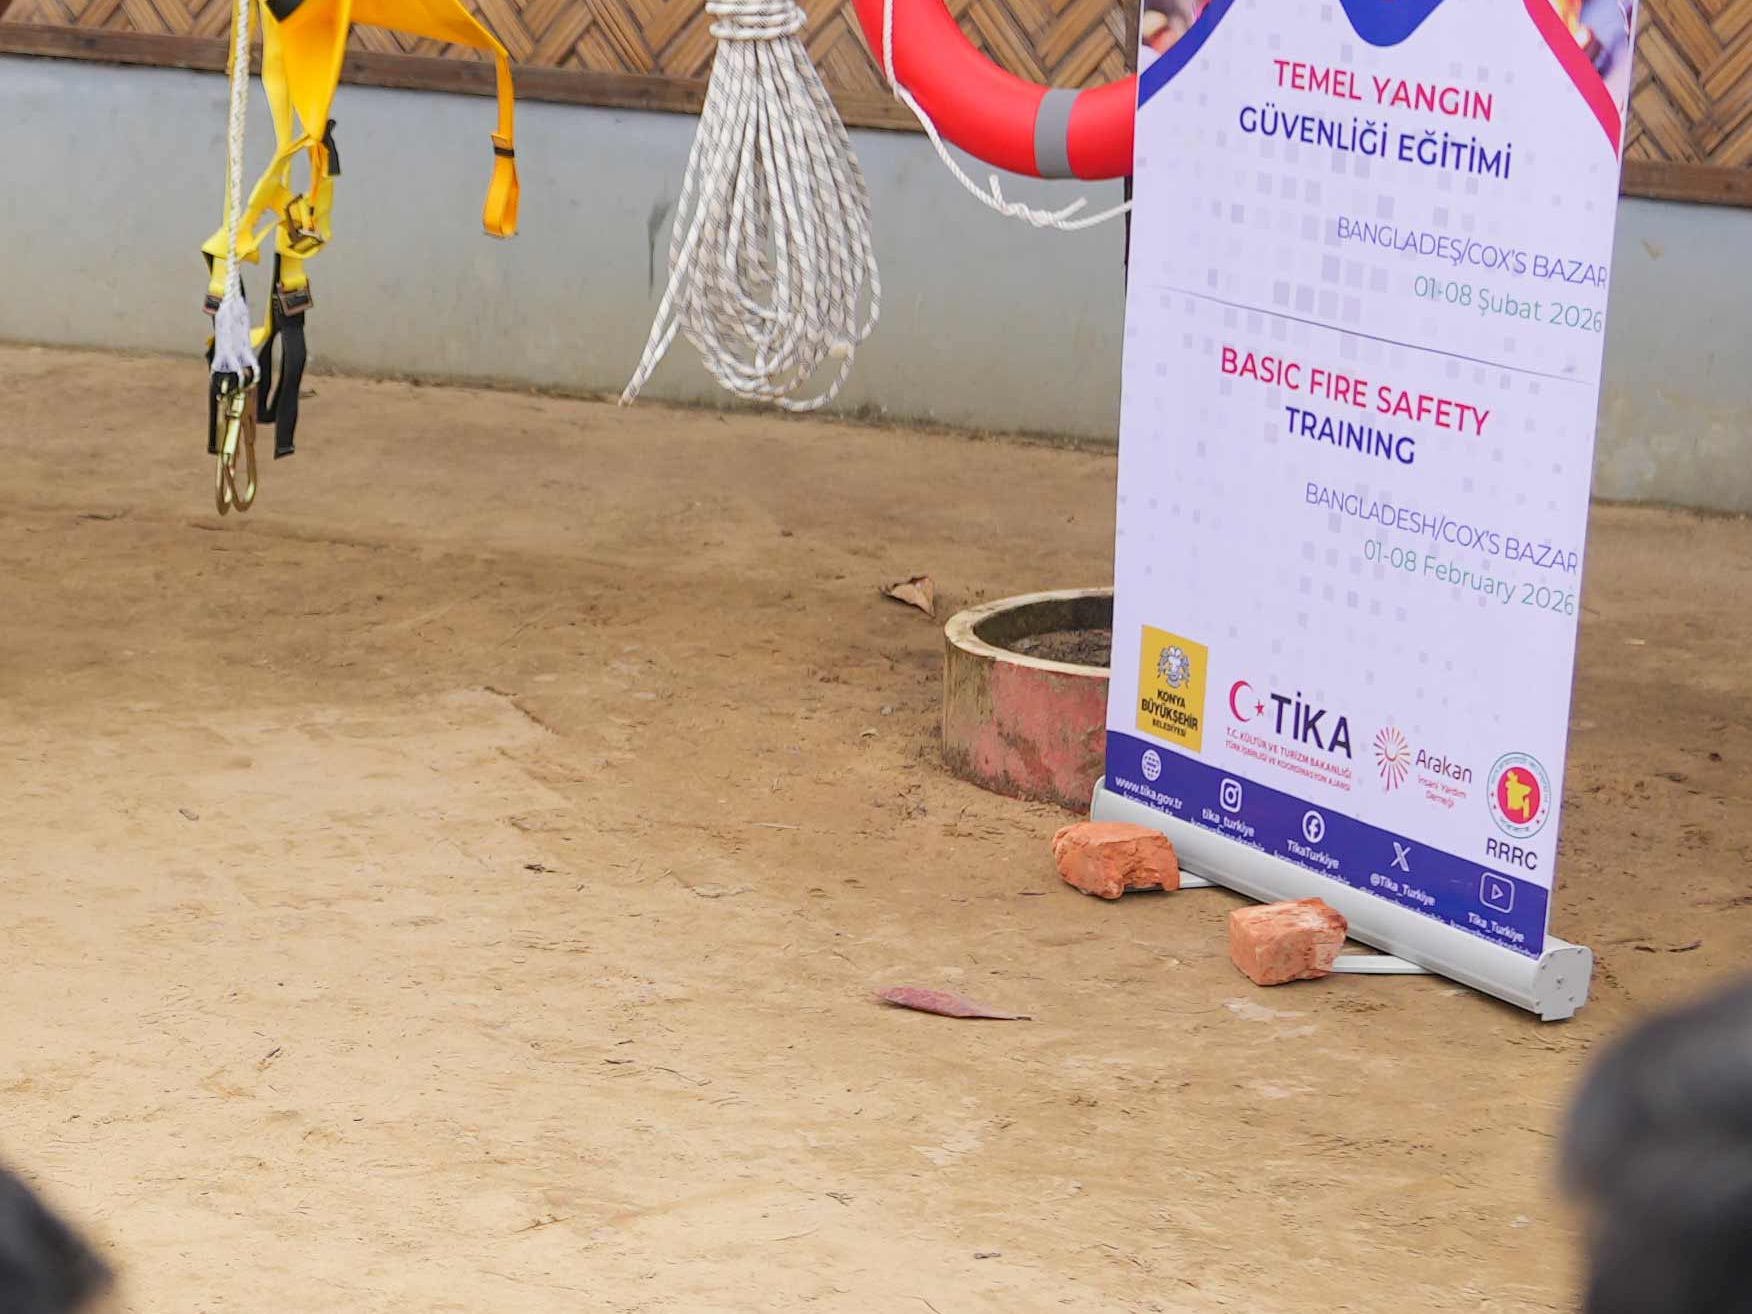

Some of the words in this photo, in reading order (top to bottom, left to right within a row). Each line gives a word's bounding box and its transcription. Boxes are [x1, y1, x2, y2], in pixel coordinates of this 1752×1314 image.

[1274, 59, 1361, 101] TEMEL
[1373, 75, 1492, 122] YANGIN
[1239, 103, 1388, 158] GÜVENLİĞİ
[1398, 129, 1512, 179] EĞİTİMİ
[1532, 255, 1607, 288] BAZAR
[1478, 288, 1543, 322] Şubat
[1549, 302, 1602, 333] 2026
[1221, 347, 1300, 390] BASIC
[1310, 369, 1368, 408] FIRE
[1376, 386, 1490, 436] SAFETY
[1285, 406, 1416, 465] TRAINING
[1305, 482, 1500, 555] BANGLADESH/COX'S
[1505, 537, 1578, 575] BAZAR
[1364, 539, 1417, 572] 01-08
[1423, 555, 1516, 605] February
[1521, 583, 1575, 616] 2026
[1141, 698, 1199, 732] BÜYÜKŞEHİR
[1156, 689, 1186, 709] KONYA
[1270, 691, 1352, 760] TİKA
[1415, 748, 1472, 785] Arakan
[1114, 775, 1183, 810] www.tika.gov.tr
[1201, 807, 1255, 838] tika_turkiye
[1286, 838, 1340, 871] TikaTurkiye
[1486, 837, 1538, 872] RRRC
[1369, 872, 1436, 907] @Tika_Turkiye
[1468, 911, 1525, 944] Tika_Turkiye
